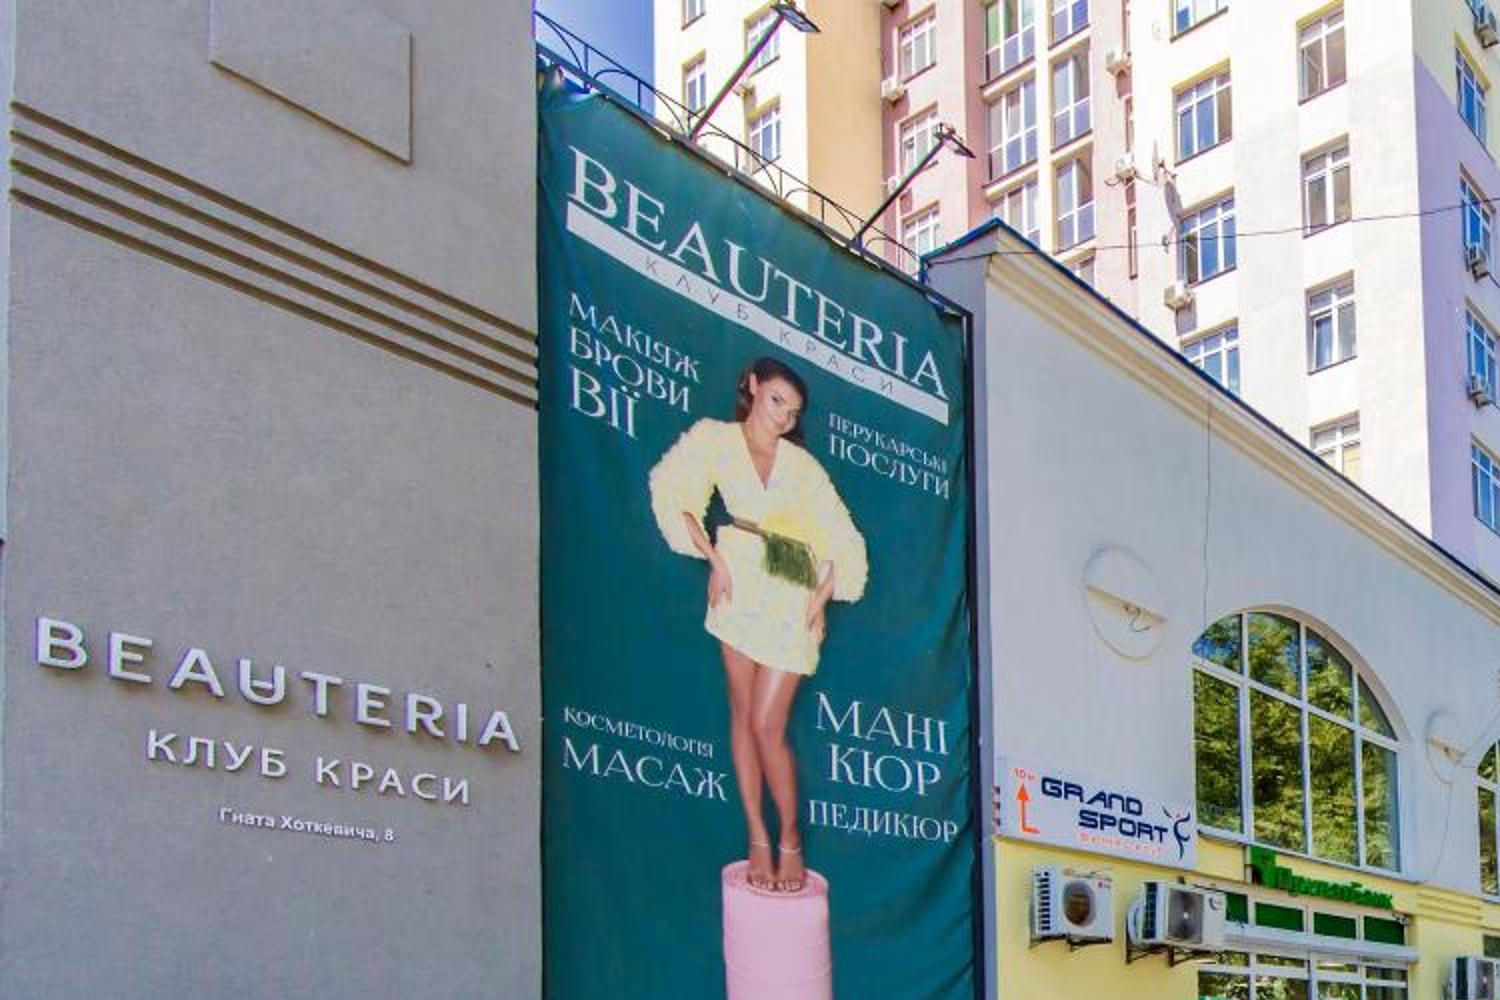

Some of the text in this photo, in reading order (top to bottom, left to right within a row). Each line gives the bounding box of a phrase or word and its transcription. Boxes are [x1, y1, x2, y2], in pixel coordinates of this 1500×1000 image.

[567, 145, 950, 400] BEAUTERIA
[569, 292, 702, 383] МАКІЯЖ
[644, 254, 895, 395] КЛУБ КРАСИ
[570, 326, 690, 414] БРОВИ
[571, 366, 638, 440] ВІЇ
[829, 412, 947, 474] ПЕРУКАРСЬКІ
[830, 433, 949, 499] ПОСЛУГИ
[36, 616, 521, 753] BEAUTERIA
[563, 705, 713, 758] КОСМЕТОЛОГІЯ
[816, 692, 949, 755] МАНІ
[147, 729, 470, 804] КЛУБ КРАСИ
[561, 736, 728, 801] МАСАЖ
[828, 743, 943, 797] КЮР
[1041, 776, 1143, 816] GRAND
[220, 807, 394, 842] Гната Хоткевича, 8
[808, 799, 958, 843] ПЕДИКЮР
[1078, 810, 1168, 843] SPORT
